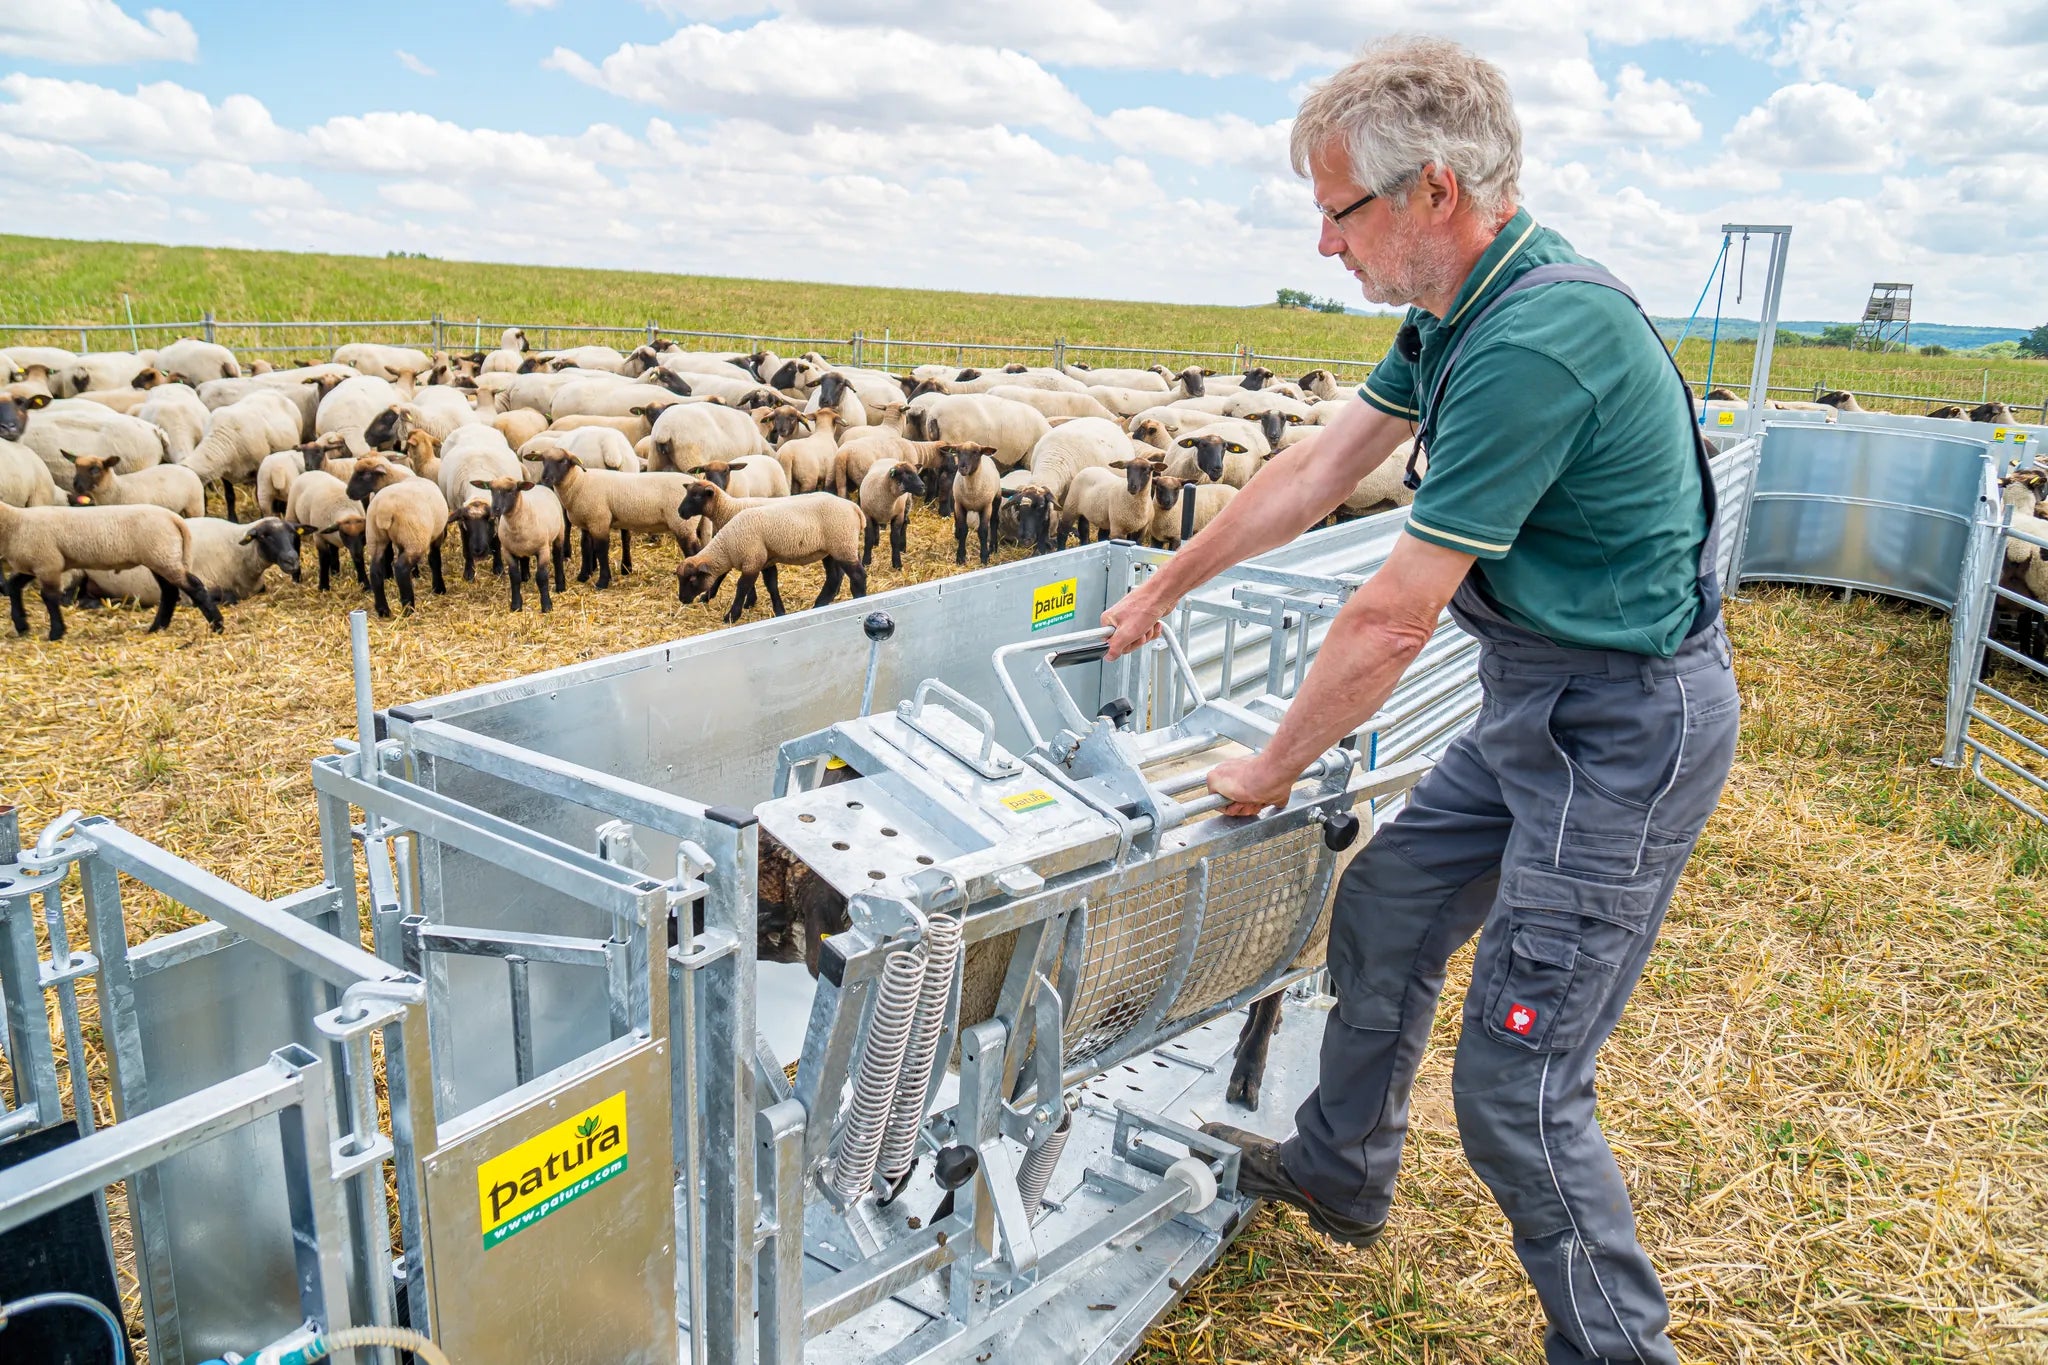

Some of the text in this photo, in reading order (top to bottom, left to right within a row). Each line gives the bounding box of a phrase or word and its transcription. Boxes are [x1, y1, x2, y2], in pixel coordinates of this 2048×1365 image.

[1035, 593, 1074, 620] patura
[1008, 794, 1047, 809] patura
[487, 1124, 621, 1223] patura
[493, 1160, 622, 1239] www.patura.com
